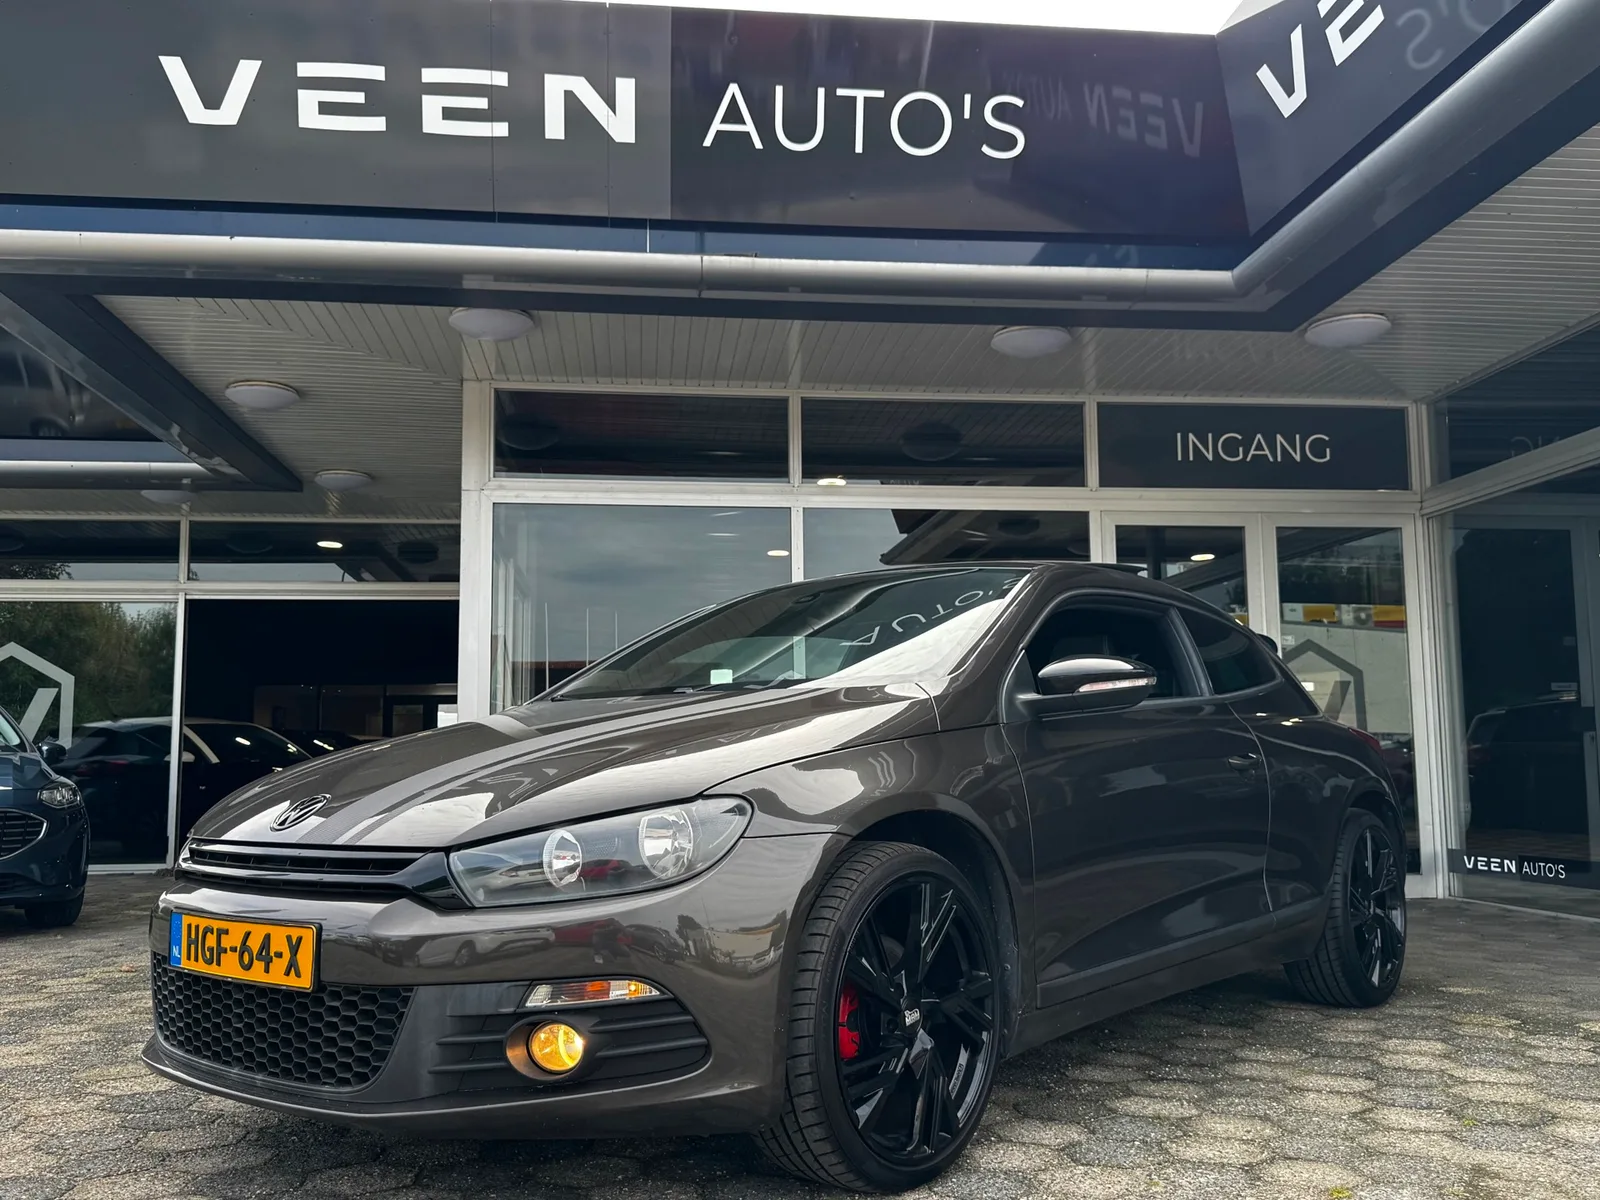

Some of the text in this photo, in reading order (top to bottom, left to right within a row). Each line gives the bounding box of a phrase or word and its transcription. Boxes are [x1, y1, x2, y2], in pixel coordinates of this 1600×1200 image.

[158, 54, 1026, 160] VEEN AUTO'S
[1176, 431, 1331, 463] INGANG
[1463, 855, 1566, 879] VEEN AUTO'S
[173, 945, 181, 958] NL
[186, 922, 303, 979] HGF-64-X
